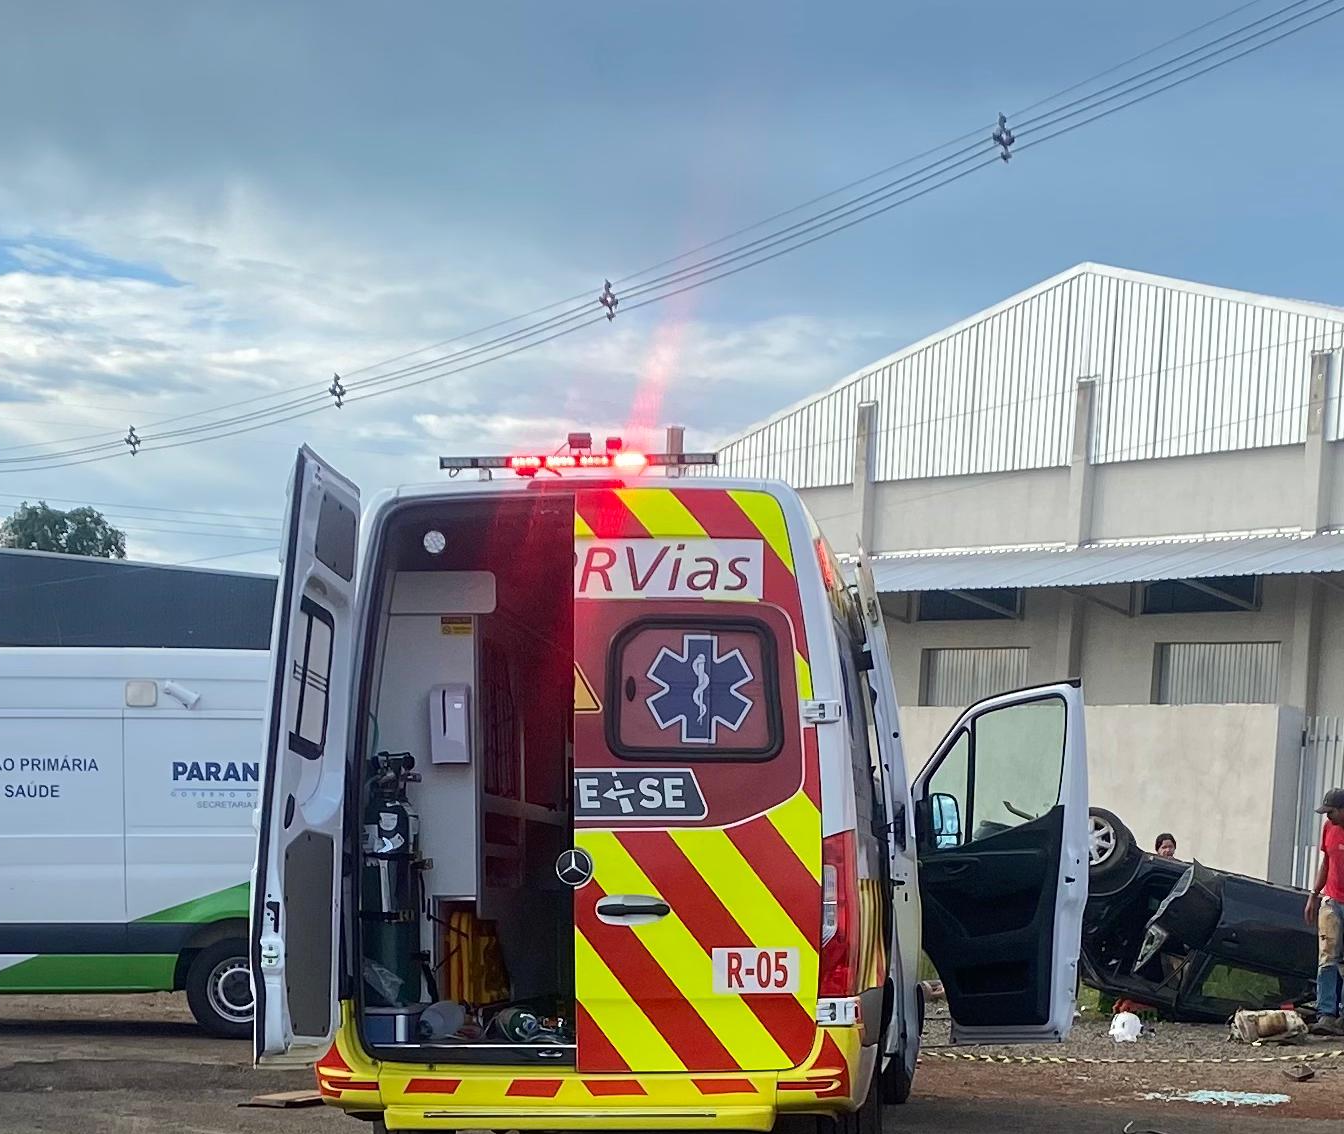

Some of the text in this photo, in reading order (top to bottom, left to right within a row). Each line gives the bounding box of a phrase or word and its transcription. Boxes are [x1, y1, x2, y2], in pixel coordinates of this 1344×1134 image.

[574, 544, 750, 592] RVias
[20, 755, 99, 772] PRIMÁRIA
[172, 762, 259, 782] PARAN
[5, 781, 60, 798] SAÚDE
[727, 951, 788, 988] R-05
